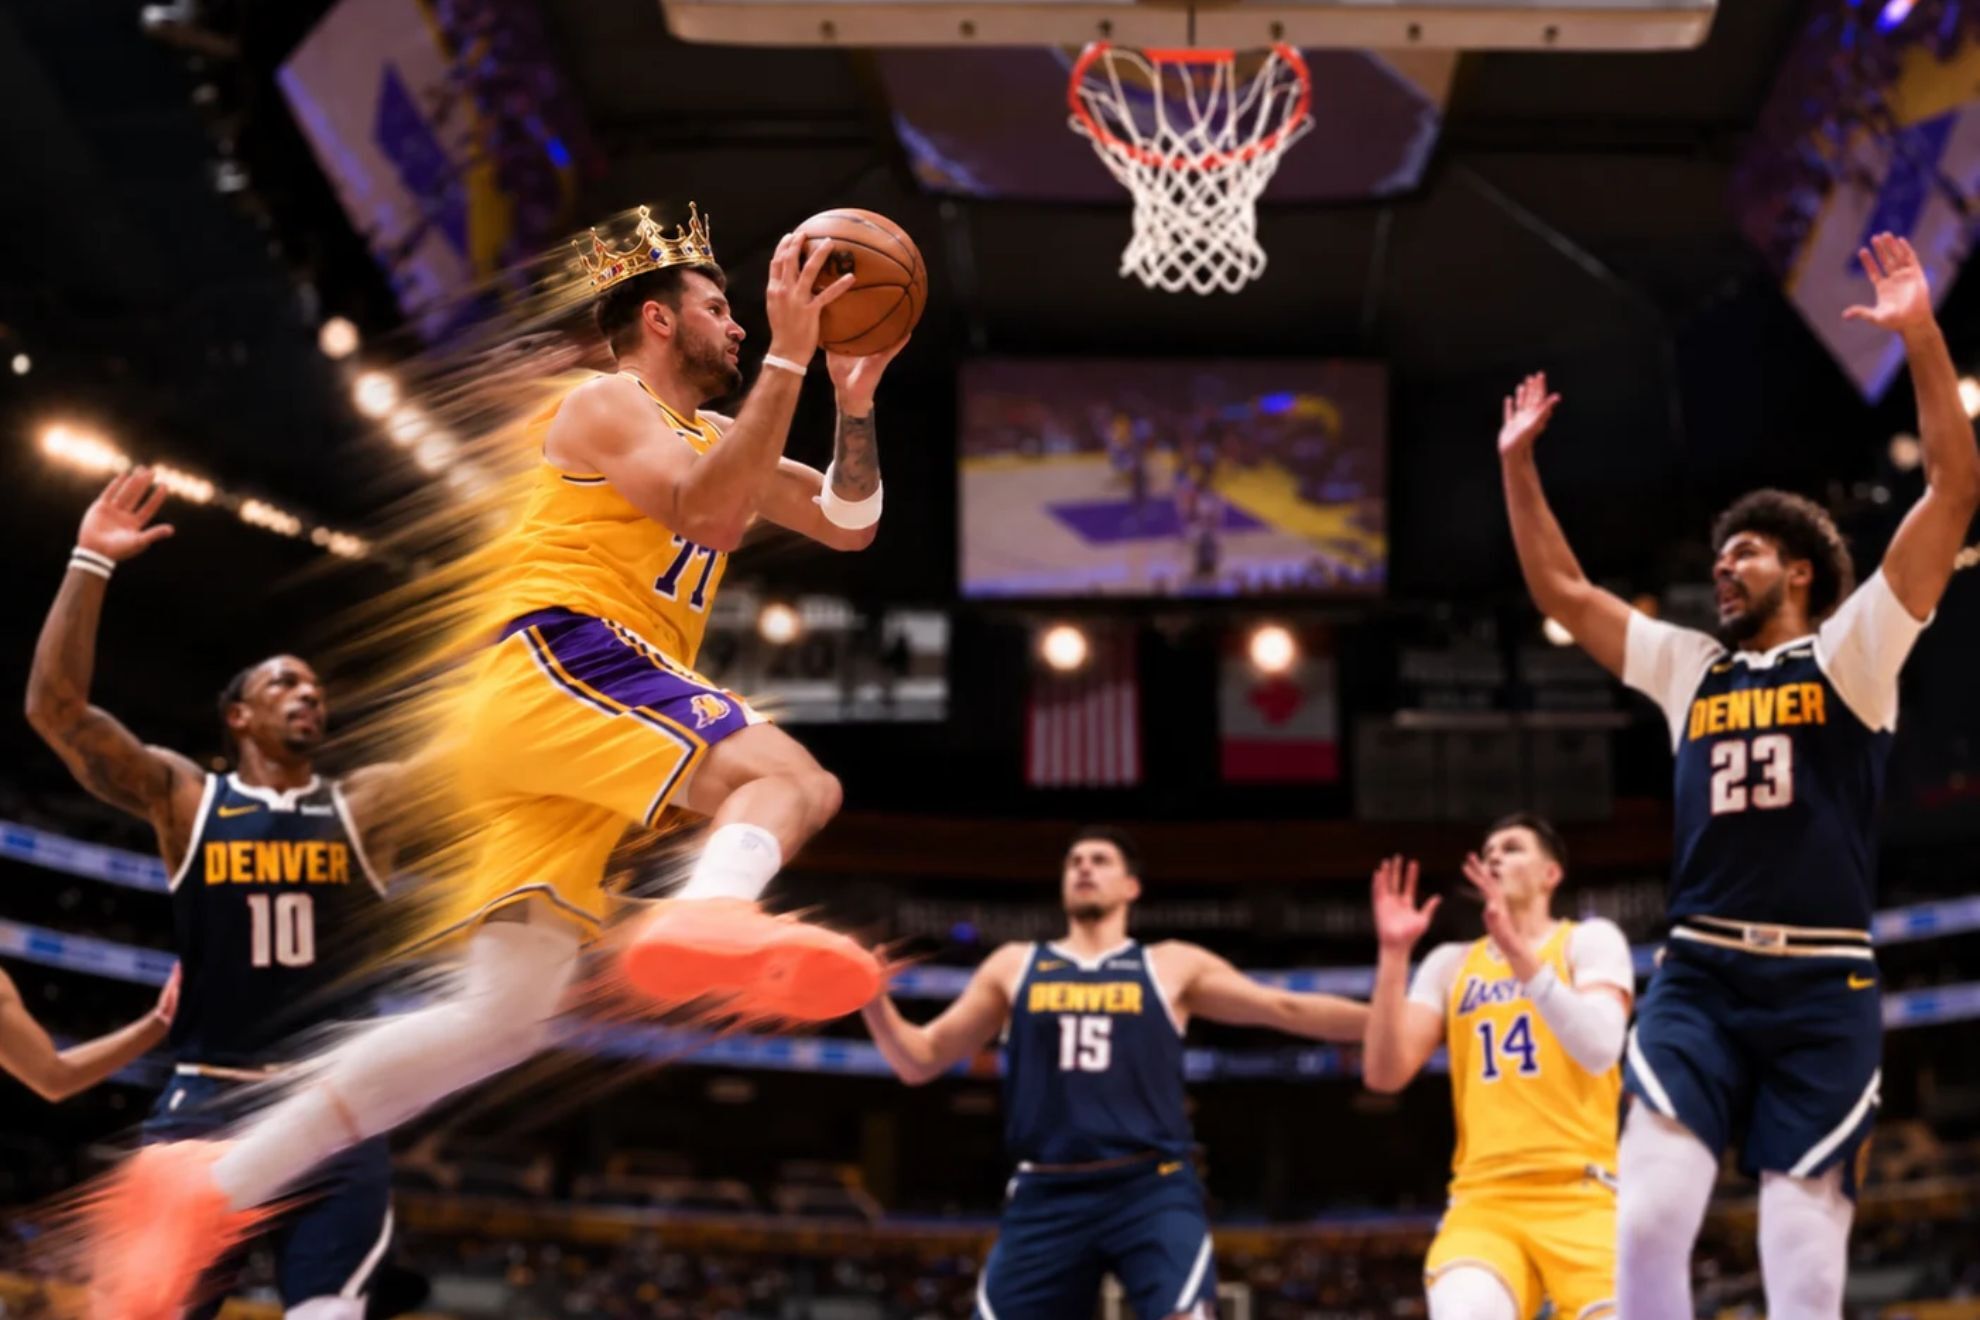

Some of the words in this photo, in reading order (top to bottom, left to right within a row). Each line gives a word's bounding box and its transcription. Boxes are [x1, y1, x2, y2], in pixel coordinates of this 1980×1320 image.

[653, 534, 718, 613] 77
[1688, 682, 1826, 742] DENVER
[1711, 733, 1794, 815] 23
[204, 840, 349, 885] DENVER
[247, 892, 315, 968] 10
[1028, 981, 1144, 1015] DENVER
[1058, 1016, 1112, 1072] 15
[1477, 1013, 1538, 1081] 14
